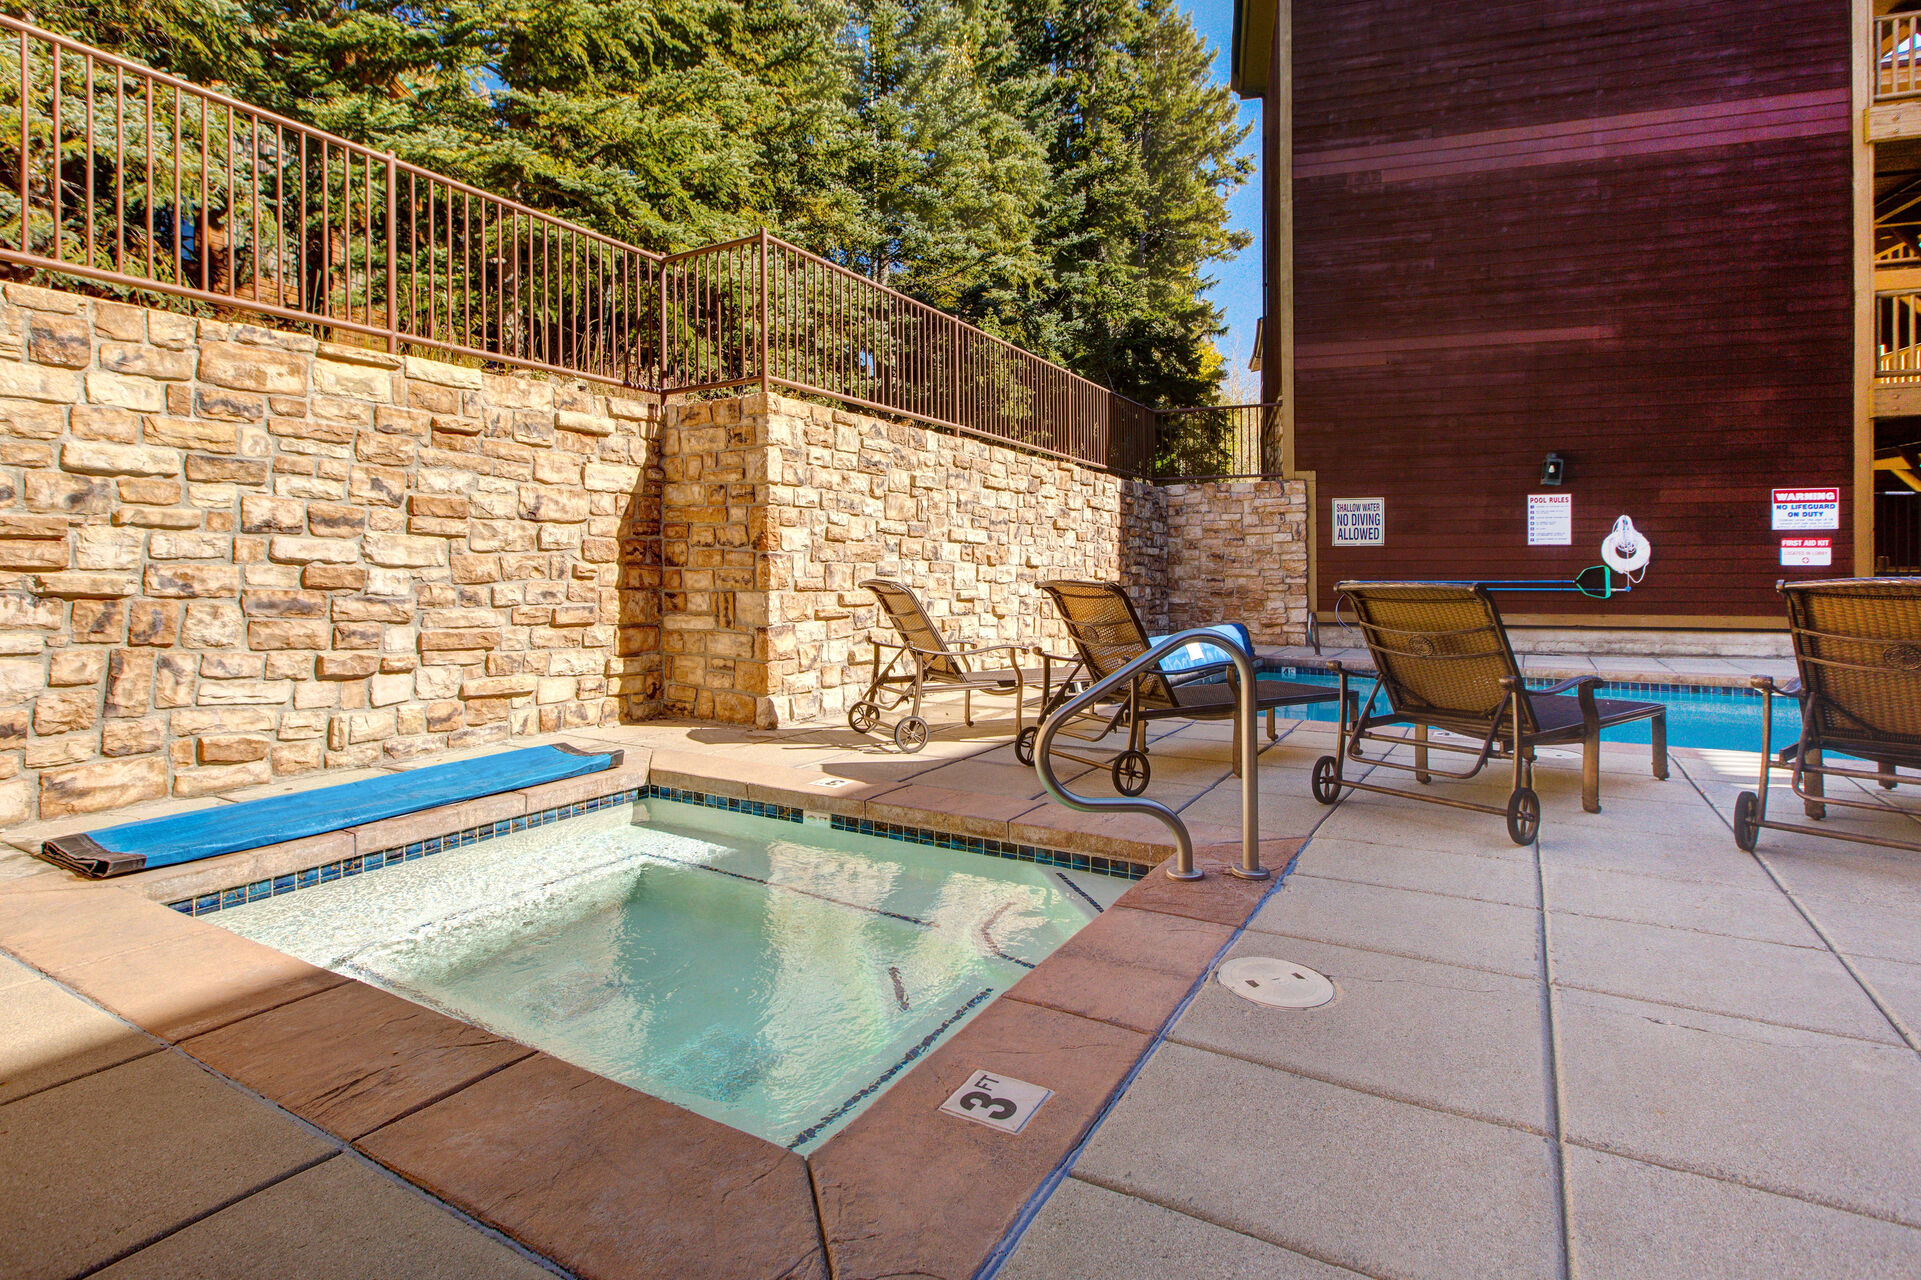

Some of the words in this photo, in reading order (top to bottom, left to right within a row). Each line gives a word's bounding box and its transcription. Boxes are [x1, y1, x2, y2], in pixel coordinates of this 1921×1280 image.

[1775, 492, 1835, 501] WARNING
[1337, 503, 1361, 512] SHALLOW
[1362, 503, 1380, 512] WATER
[1337, 513, 1349, 526] NO
[1351, 513, 1380, 526] DIVING
[1337, 527, 1379, 540] ALLOWED
[974, 1074, 999, 1091] FT
[960, 1091, 1017, 1120] 3
